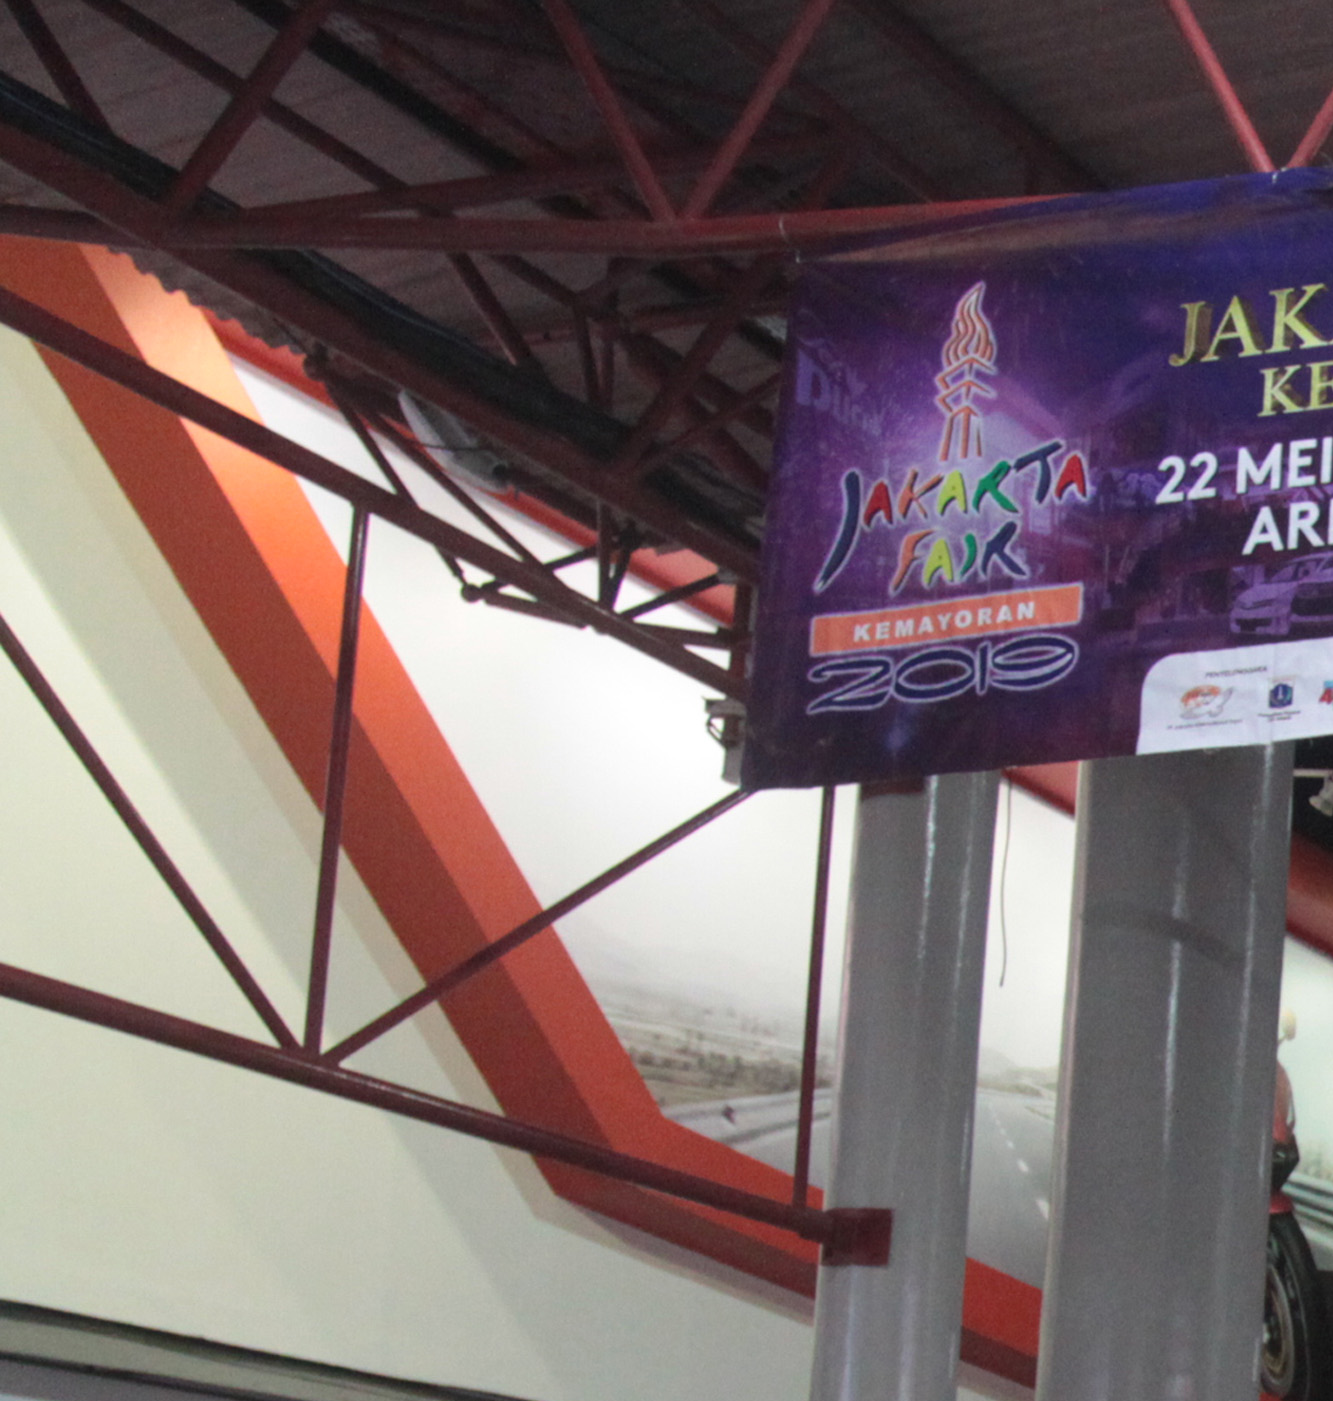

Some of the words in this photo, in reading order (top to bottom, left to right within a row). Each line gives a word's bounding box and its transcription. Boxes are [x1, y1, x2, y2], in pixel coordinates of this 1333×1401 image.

[1155, 450, 1218, 504] 22
[1235, 436, 1333, 495] MEI
[814, 440, 1088, 592] JAKARTA
[889, 519, 1029, 595] FAIR
[853, 601, 1036, 643] KEMAYORAN
[807, 633, 1079, 715] 2019
